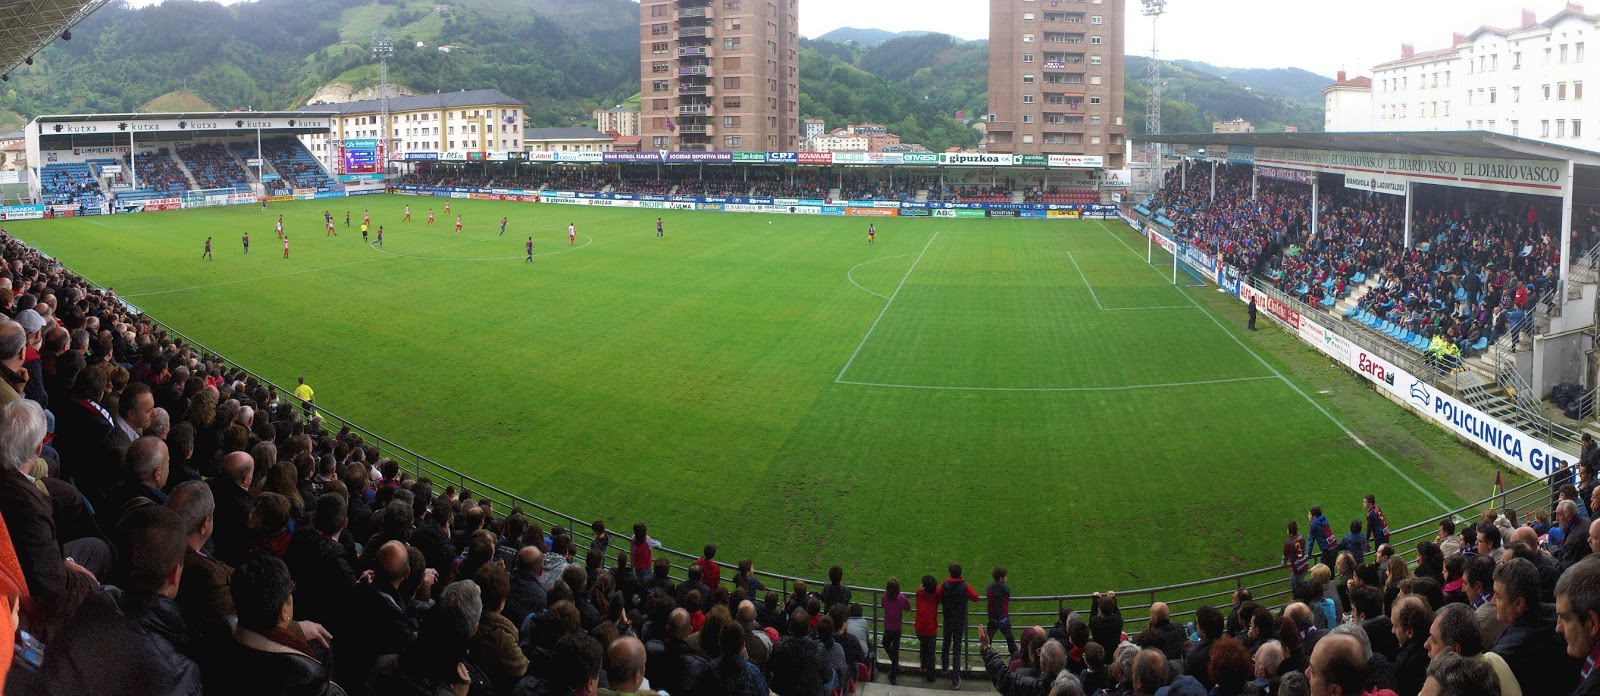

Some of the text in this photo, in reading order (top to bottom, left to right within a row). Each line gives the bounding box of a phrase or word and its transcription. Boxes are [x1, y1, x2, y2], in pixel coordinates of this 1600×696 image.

[68, 124, 97, 132] kutxa
[132, 122, 159, 130] kutxa
[190, 121, 217, 129] kutxa
[950, 154, 999, 164] gipuzkoa
[1332, 154, 1384, 169] EL DIARIO VASCO
[1388, 158, 1457, 174] EL DIARIO VASCO
[1464, 162, 1560, 183] EL DIARIO VASCO
[1358, 352, 1386, 382] gara
[1435, 396, 1523, 462] POLICLINICA
